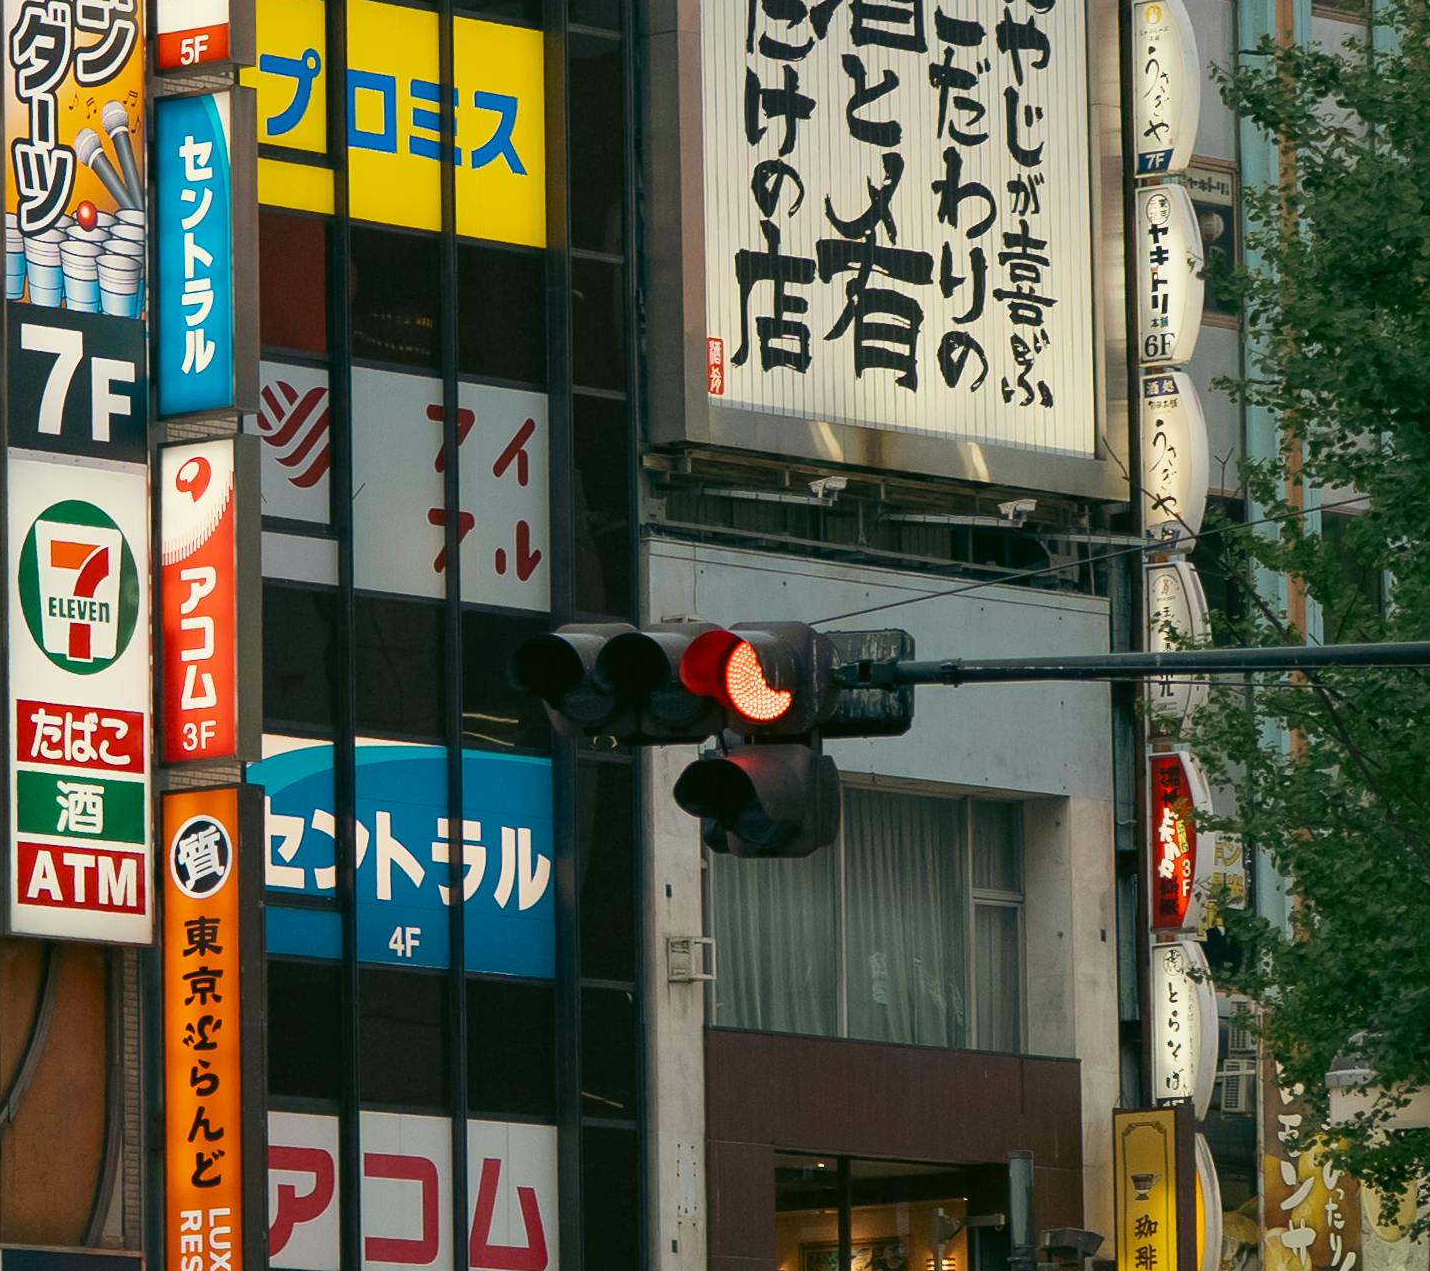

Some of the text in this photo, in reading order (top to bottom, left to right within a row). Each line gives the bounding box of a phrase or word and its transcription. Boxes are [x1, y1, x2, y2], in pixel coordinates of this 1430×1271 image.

[178, 36, 210, 65] 5F
[259, 48, 528, 177] プロミス
[1144, 151, 1166, 171] 7F
[179, 133, 217, 375] セントラル
[1147, 225, 1170, 314] ヤキトリ
[1144, 331, 1175, 360] 6F
[20, 323, 136, 442] 7F
[180, 565, 218, 711] アコム
[30, 705, 131, 759] たばこ
[181, 721, 217, 753] 3F
[55, 781, 106, 834] 酒
[26, 851, 138, 909] ATM
[176, 824, 226, 891] 質
[263, 796, 552, 912] セントラル
[387, 926, 422, 959] 4F
[181, 915, 225, 1190] 東京ぶらんど
